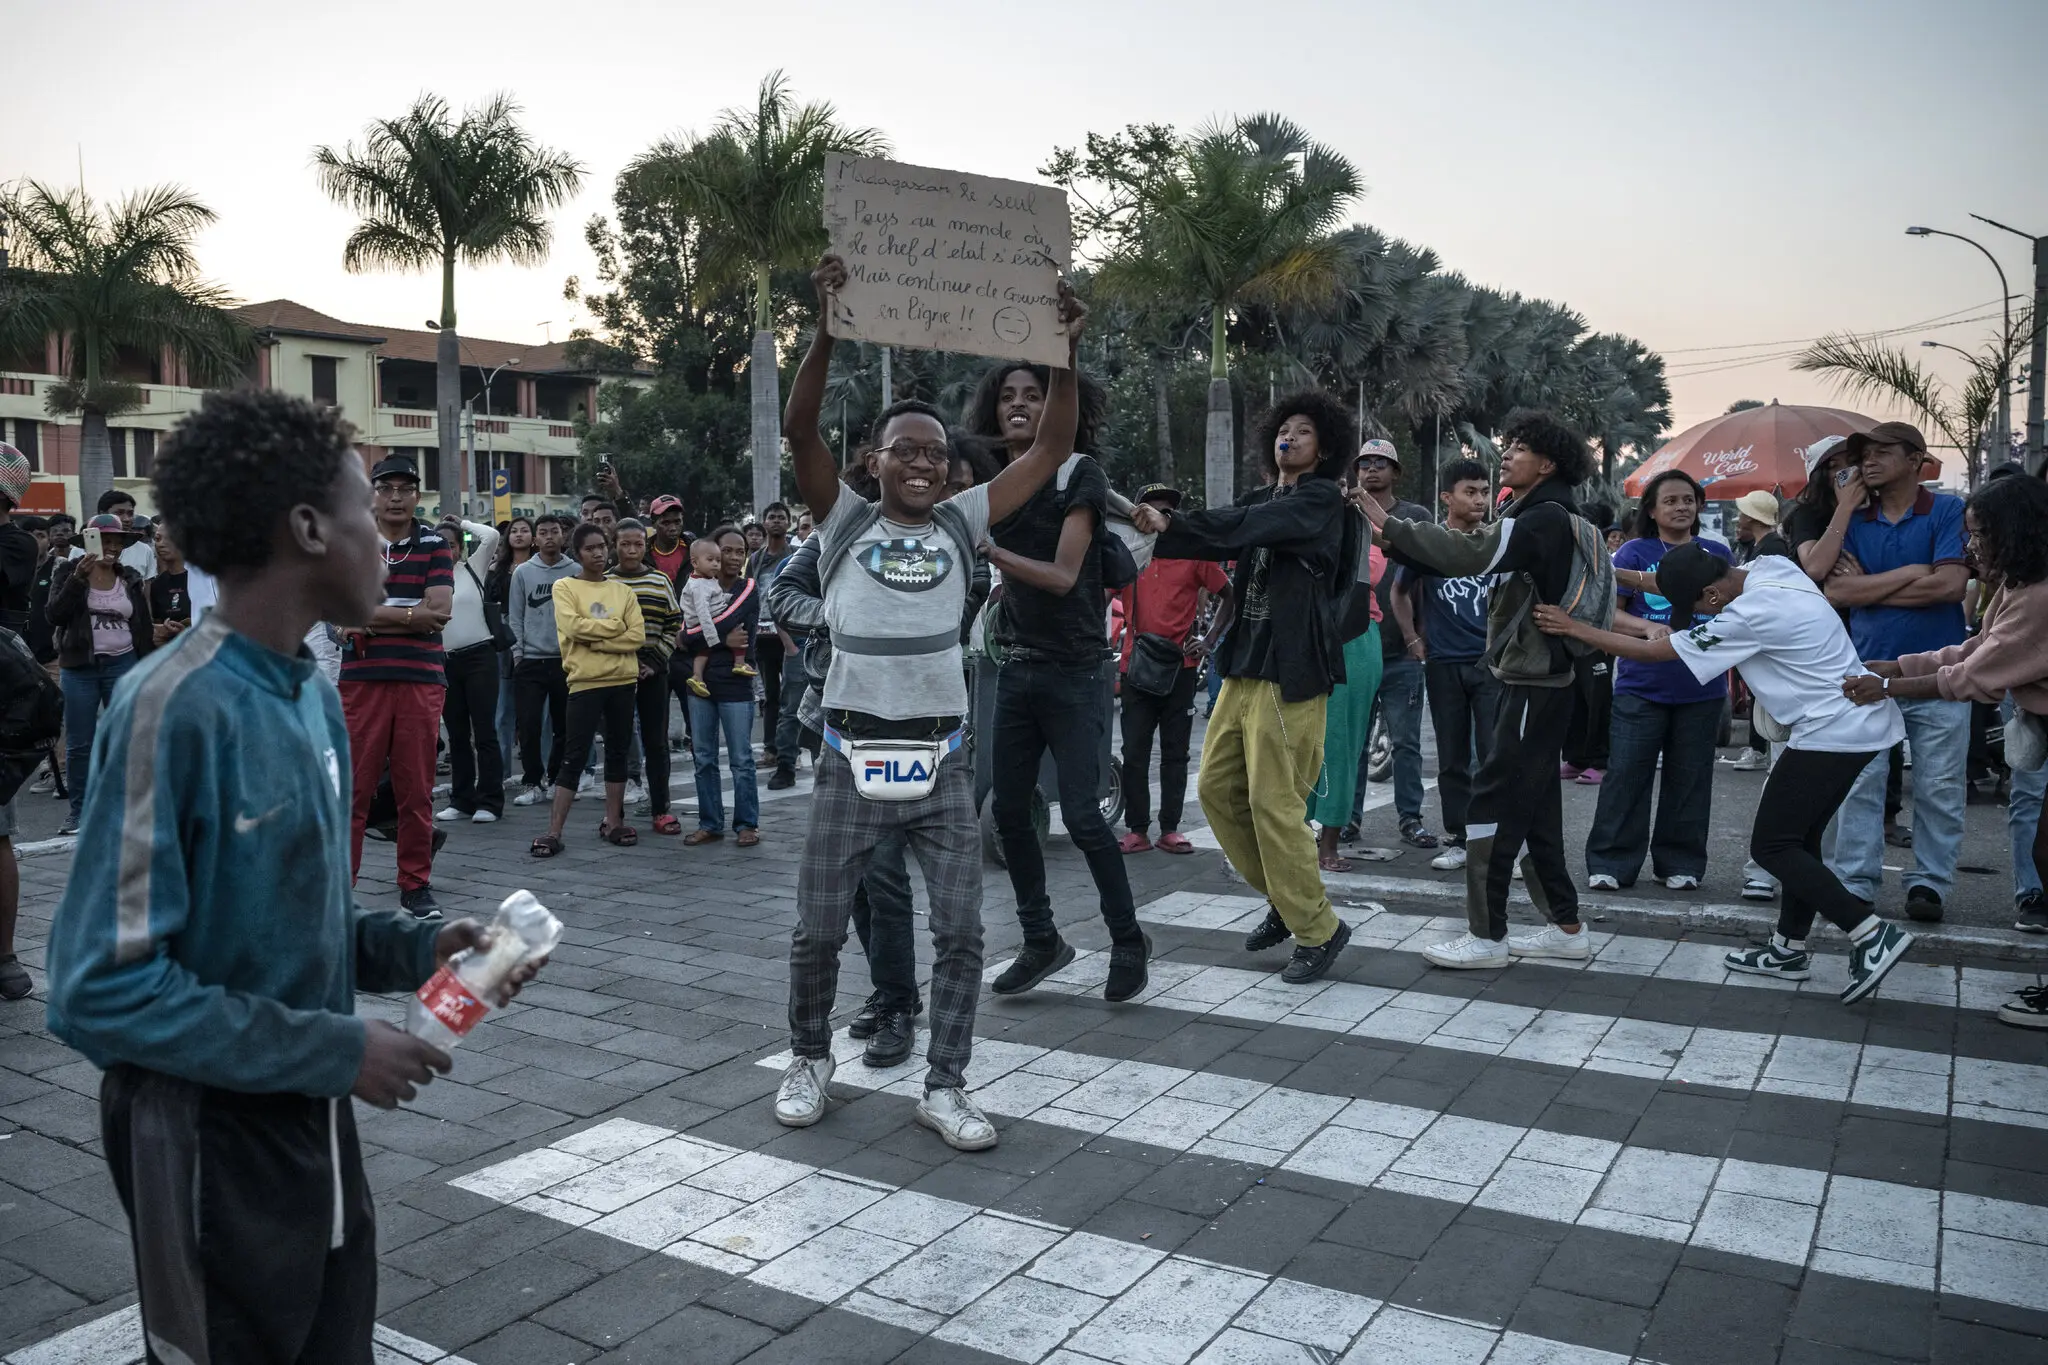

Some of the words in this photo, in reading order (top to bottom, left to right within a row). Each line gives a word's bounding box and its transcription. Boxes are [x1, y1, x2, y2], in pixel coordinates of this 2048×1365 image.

[960, 182, 977, 202] le
[988, 190, 1037, 215] seul
[854, 199, 899, 237] Pays
[909, 216, 937, 228] au
[948, 220, 1012, 240] monde
[1024, 224, 1045, 247] où
[849, 231, 868, 256] le
[877, 234, 920, 267] chef
[849, 264, 891, 284] Mais
[897, 270, 972, 293] continue
[976, 280, 998, 298] de
[908, 296, 950, 332] ligne
[1703, 444, 1755, 466] World
[1713, 457, 1759, 476] Cola
[535, 583, 553, 595] NIK
[865, 760, 928, 782] FILA
